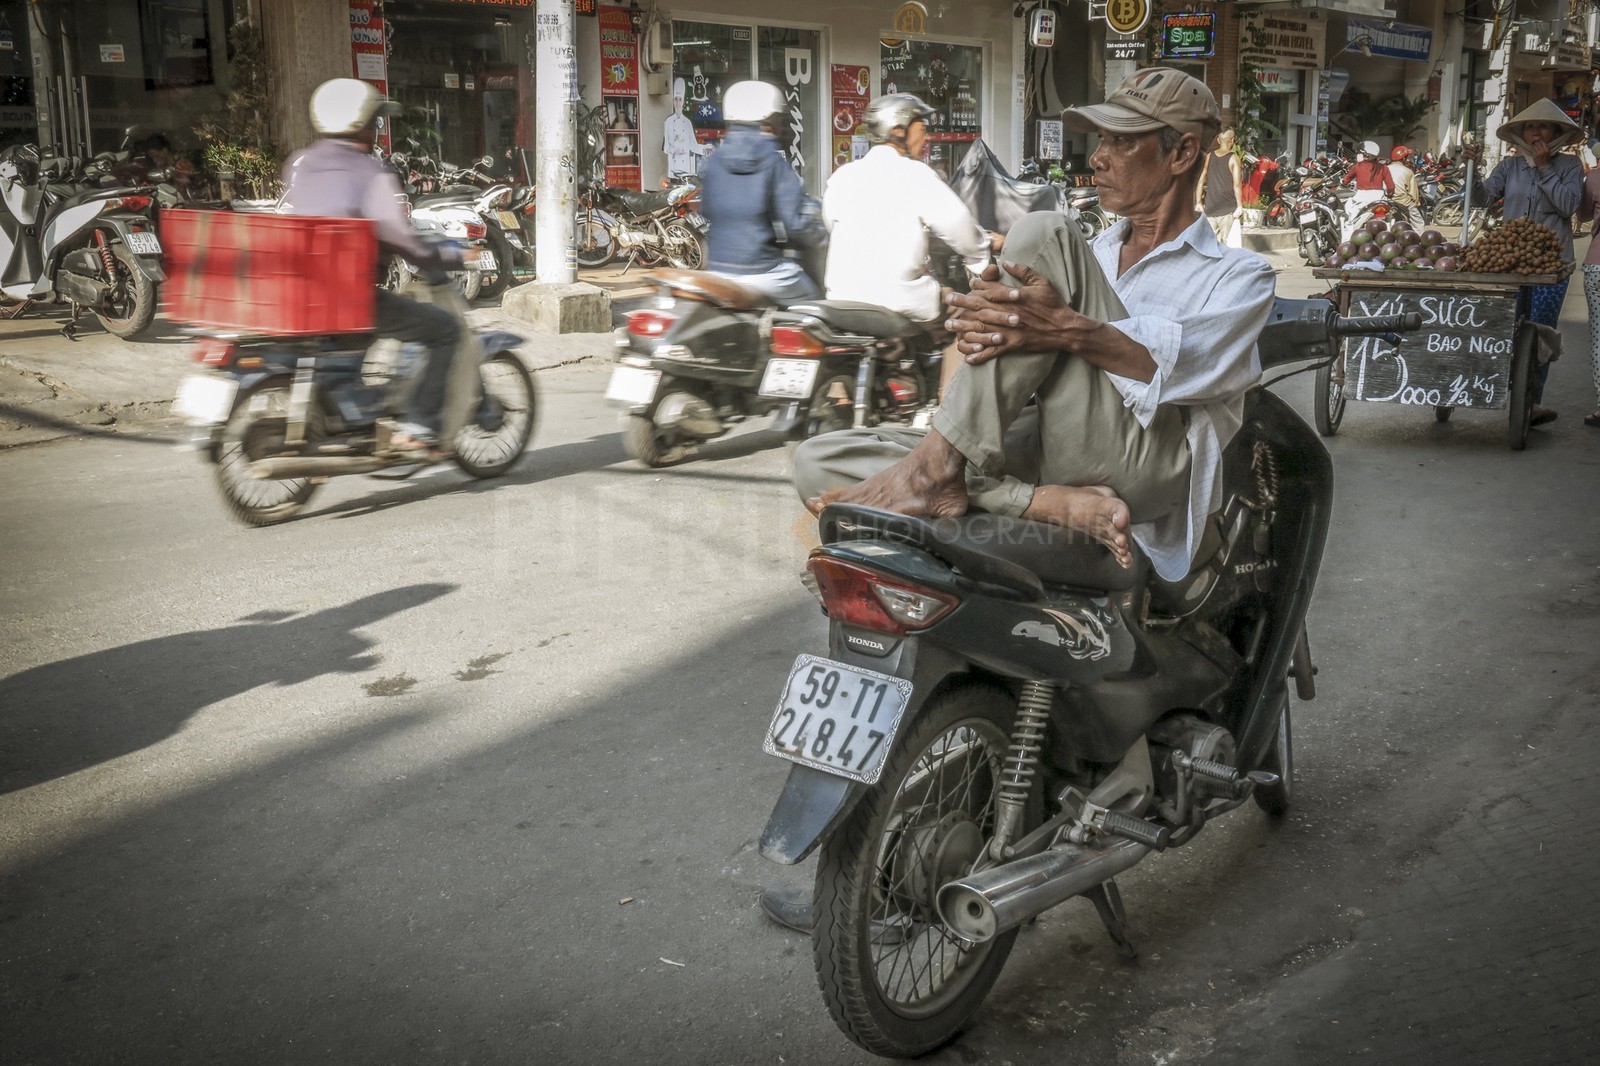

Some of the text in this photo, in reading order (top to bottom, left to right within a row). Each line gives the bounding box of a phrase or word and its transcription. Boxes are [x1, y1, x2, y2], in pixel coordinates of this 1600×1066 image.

[1170, 28, 1205, 46] Spa
[1115, 50, 1136, 58] 24/7
[1427, 333, 1462, 353] BAO
[848, 635, 884, 650] HONDA
[800, 665, 888, 723] 59-T1
[773, 707, 885, 771] 248.47
